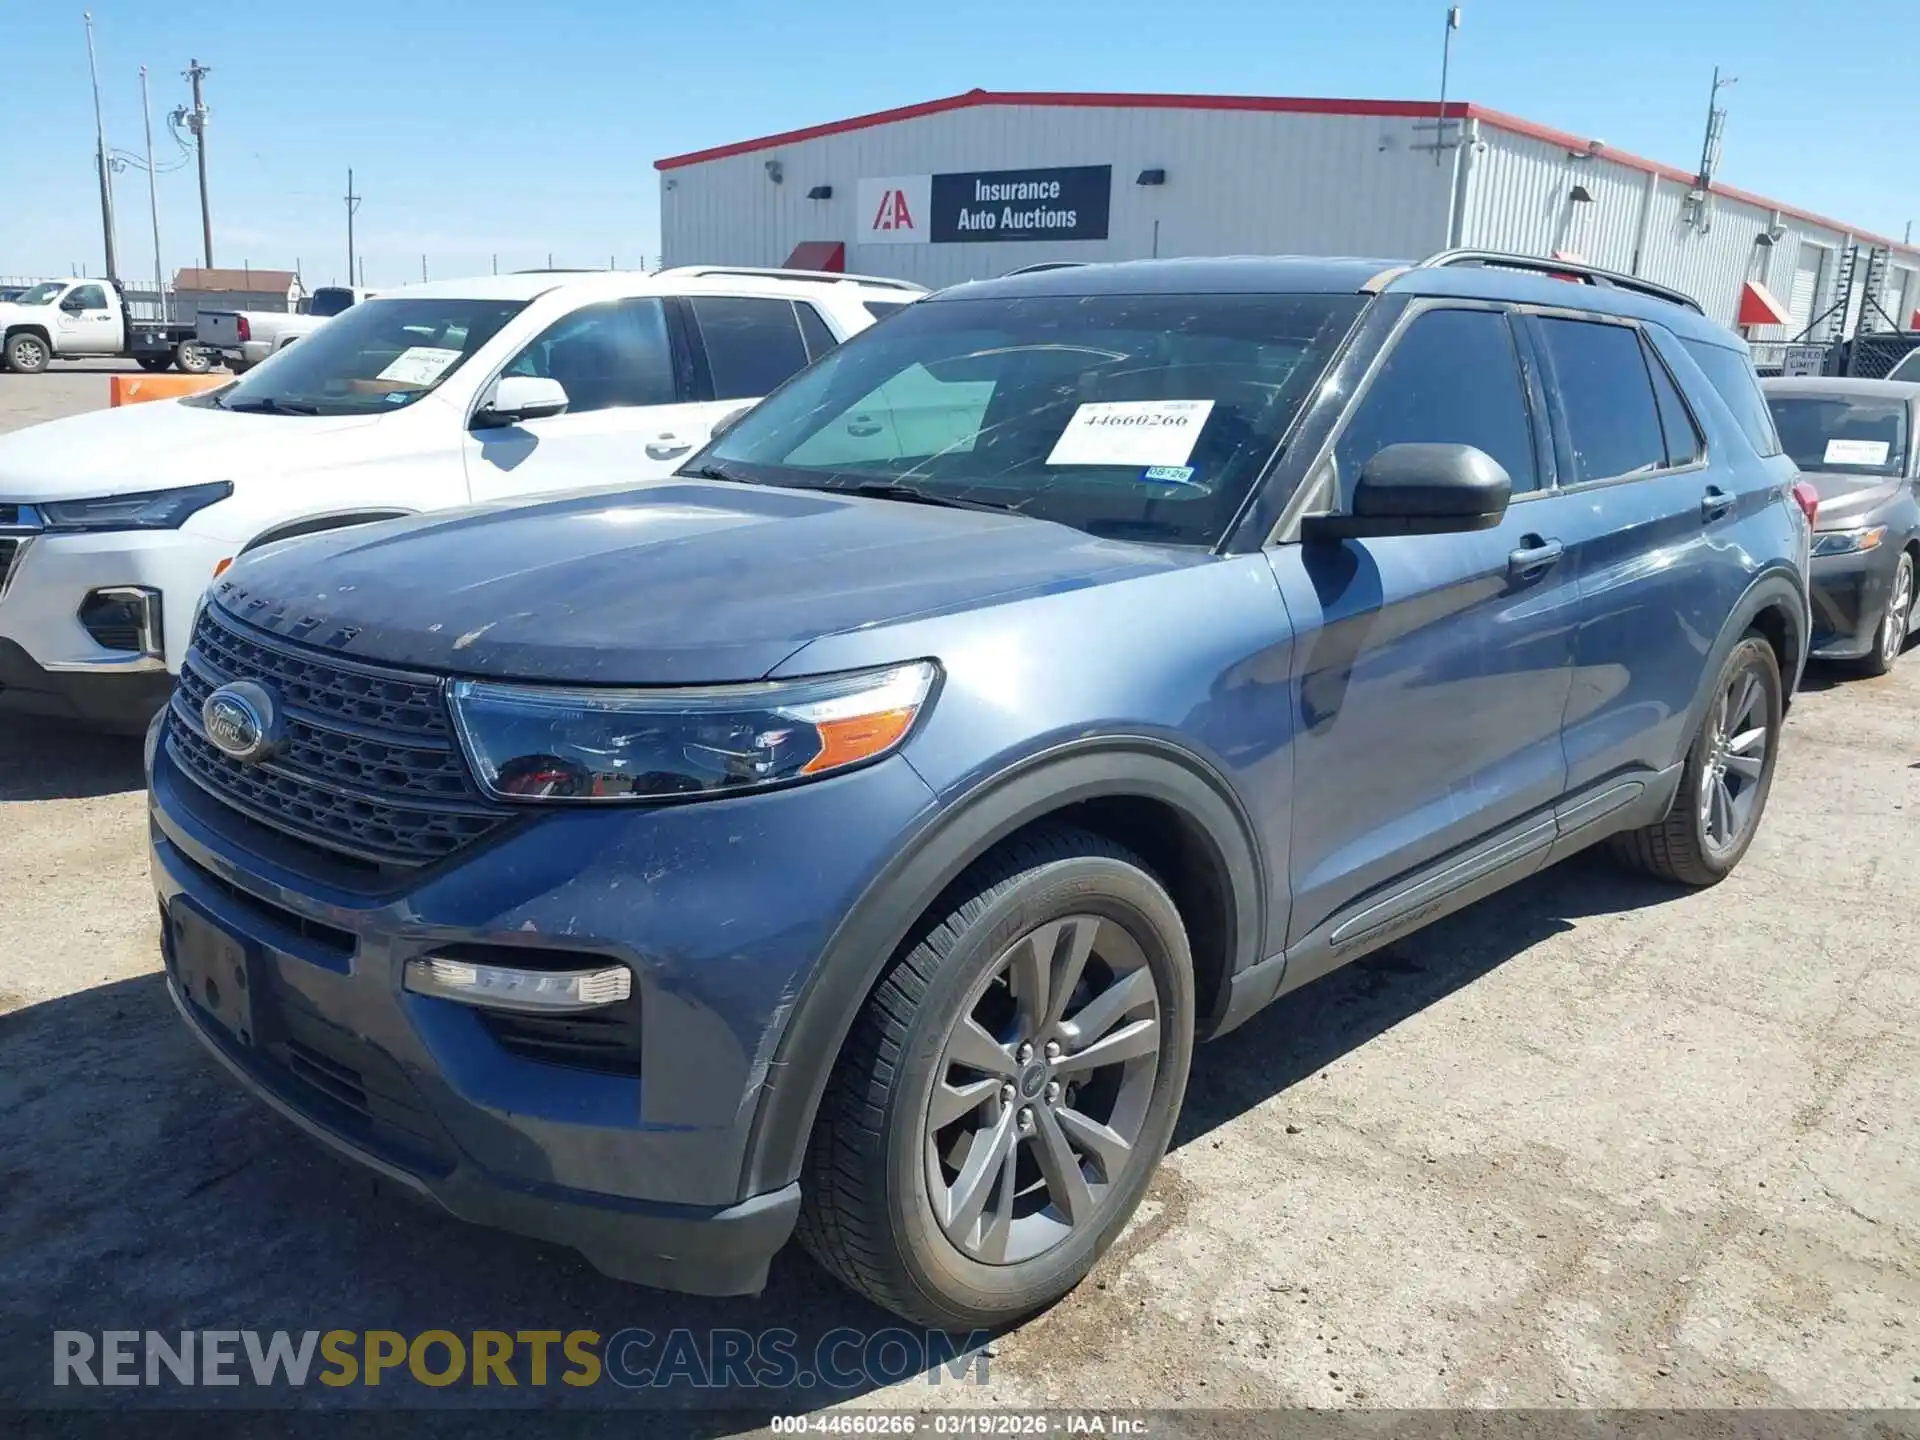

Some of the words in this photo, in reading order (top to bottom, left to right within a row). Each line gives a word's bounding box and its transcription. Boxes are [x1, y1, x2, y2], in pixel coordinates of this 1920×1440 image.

[976, 179, 1060, 201] Insurance
[958, 208, 996, 230] Auto
[1000, 205, 1077, 229] Auctions
[1788, 351, 1821, 359] SPEED
[1790, 361, 1815, 369] LIMIT
[1083, 413, 1188, 427] 44660266
[210, 702, 242, 742] Ford
